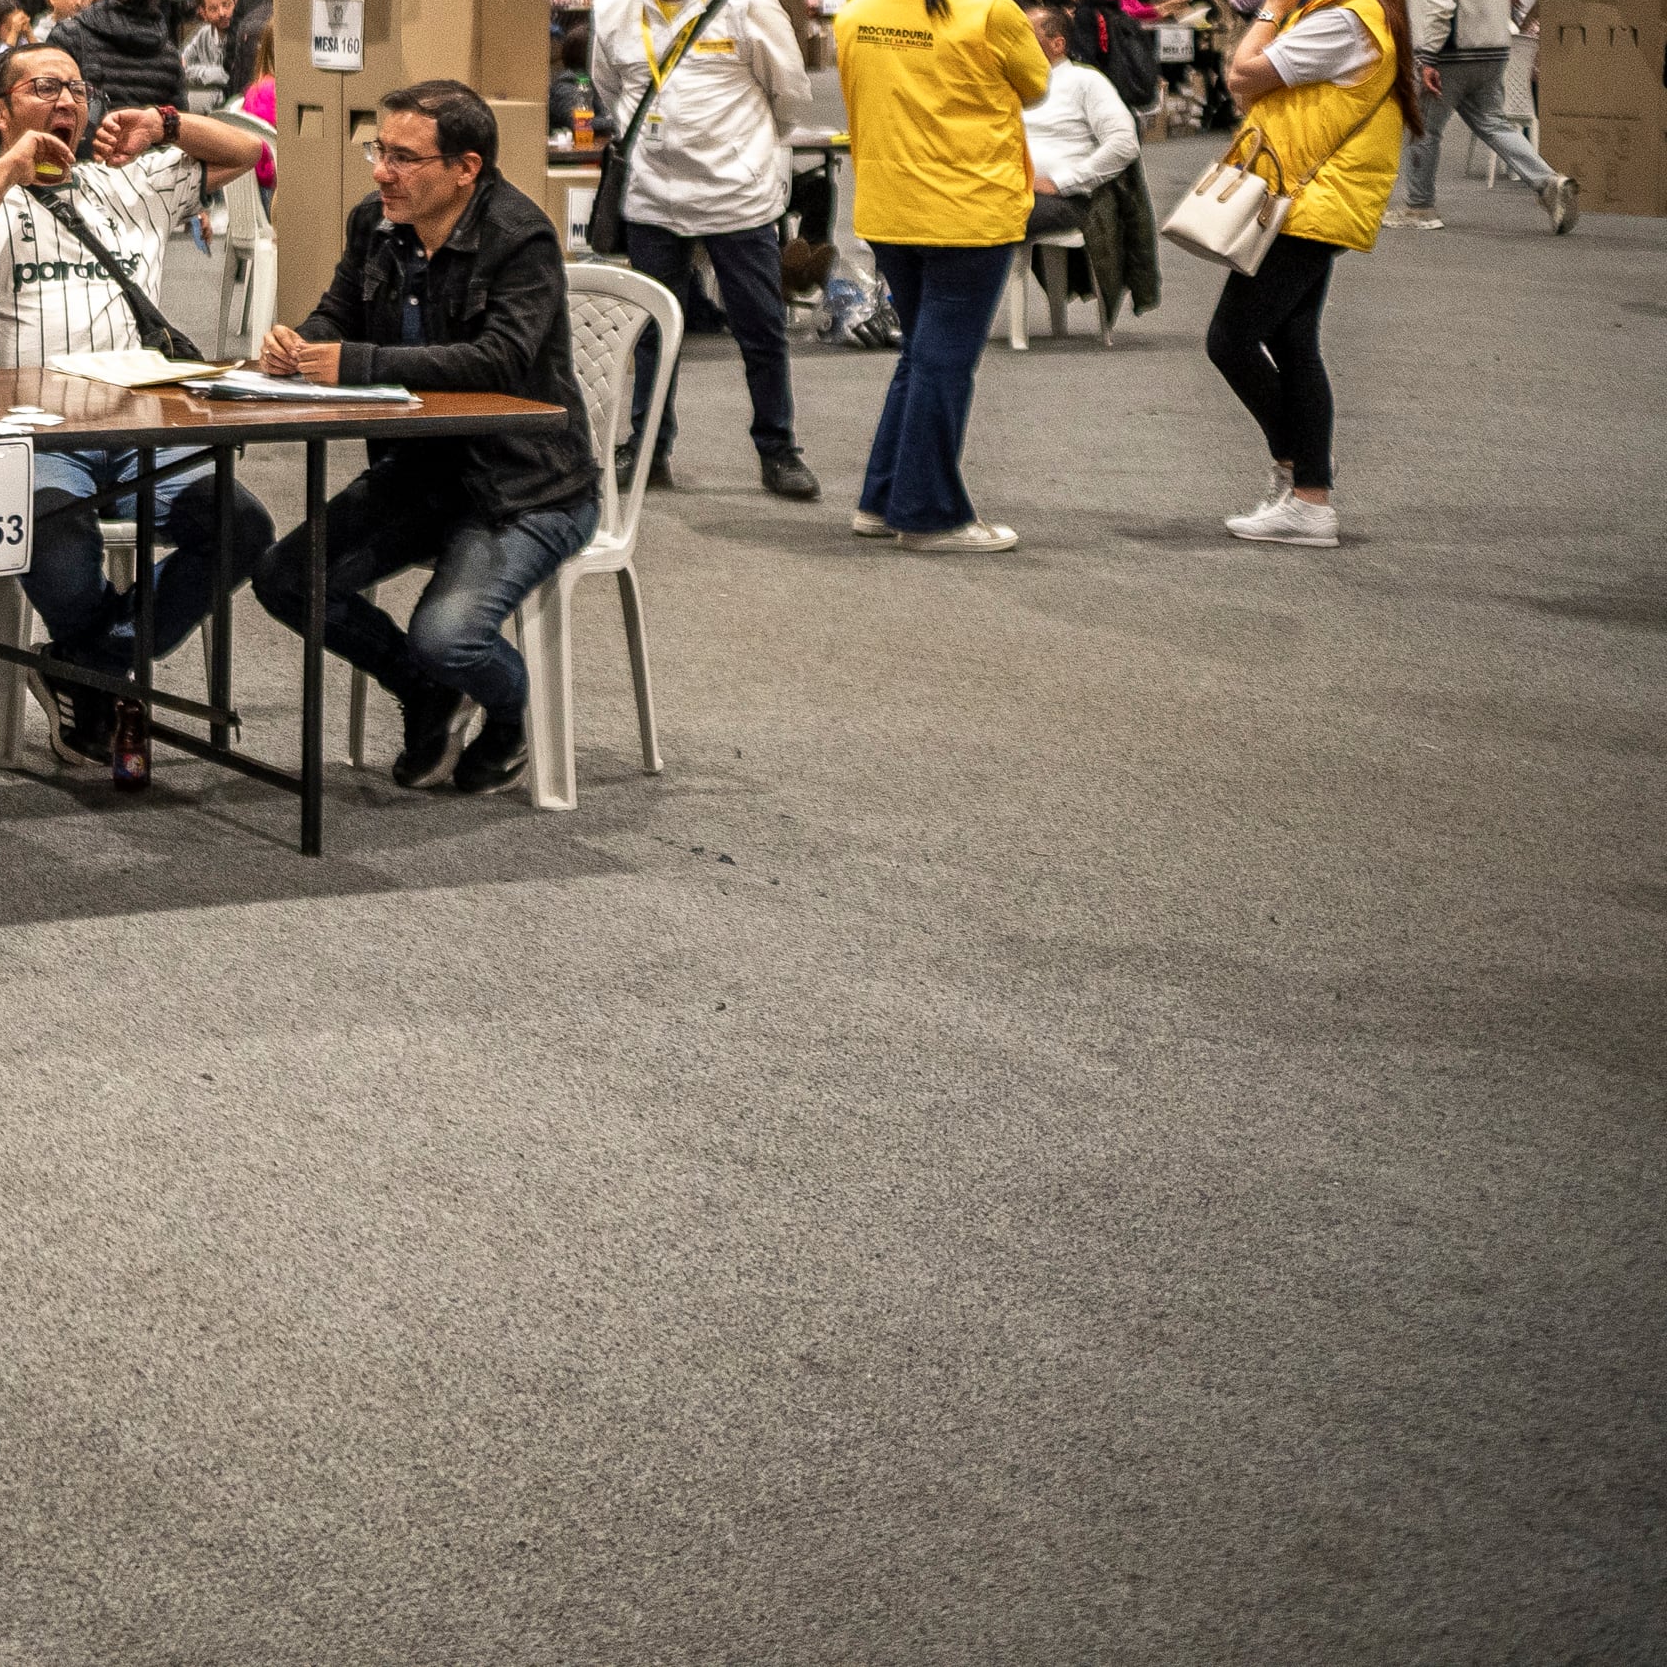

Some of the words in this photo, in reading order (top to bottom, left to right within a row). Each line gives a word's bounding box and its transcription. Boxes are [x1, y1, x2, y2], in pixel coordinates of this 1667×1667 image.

[858, 25, 934, 41] PROCURADURÍA
[314, 36, 340, 53] MESA
[341, 37, 360, 54] 160
